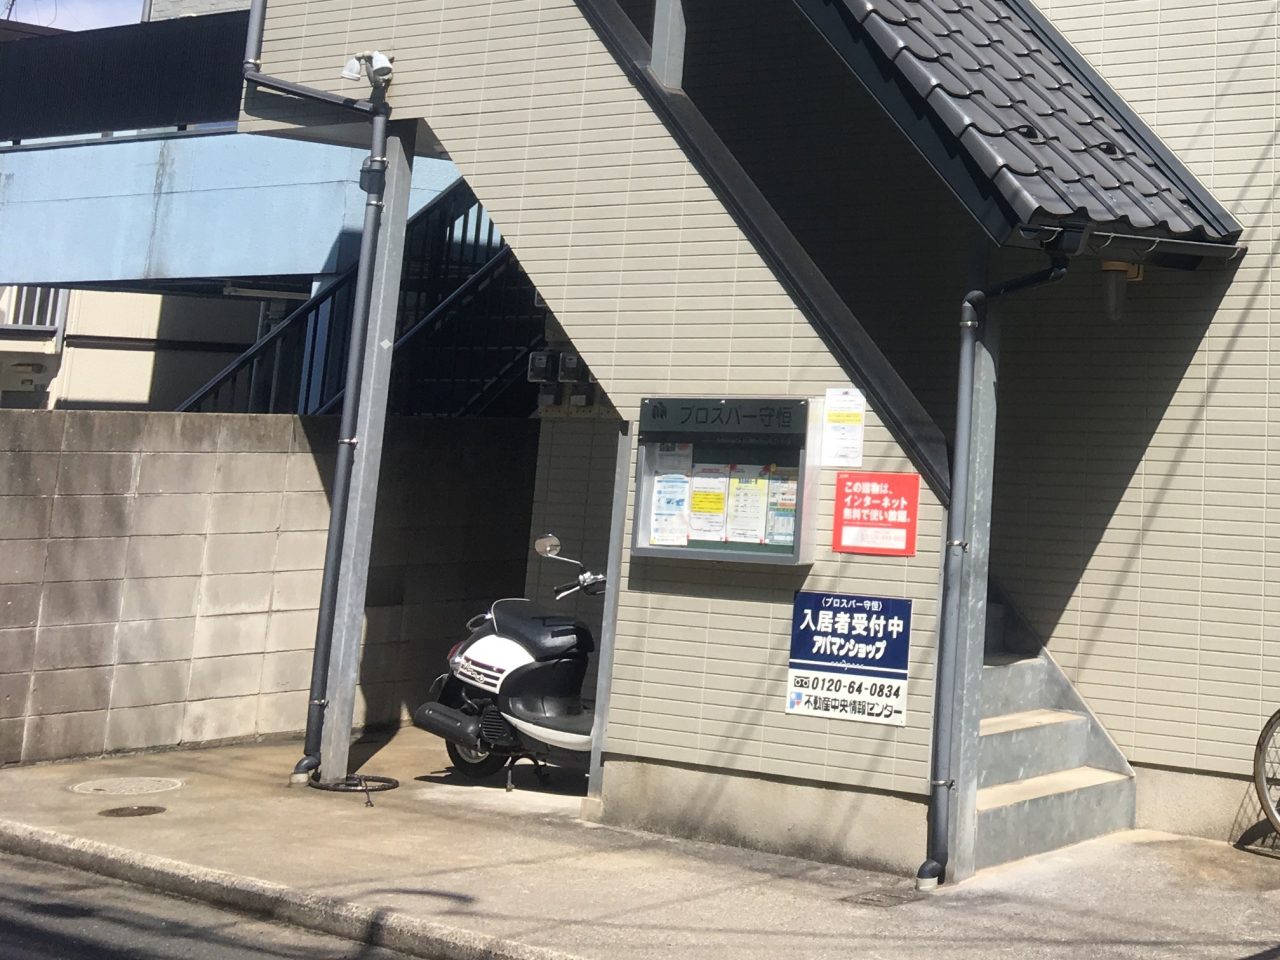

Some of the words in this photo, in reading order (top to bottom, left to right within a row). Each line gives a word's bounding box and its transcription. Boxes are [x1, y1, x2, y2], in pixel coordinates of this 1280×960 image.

[680, 405, 793, 428] プロスパー守恒
[844, 494, 908, 509] インターネット
[800, 609, 904, 638] 入居者受付中
[812, 635, 887, 660] アパマンショップ
[811, 677, 901, 699] 0120-64-0834
[803, 694, 903, 718] 不動産中央情報センター
